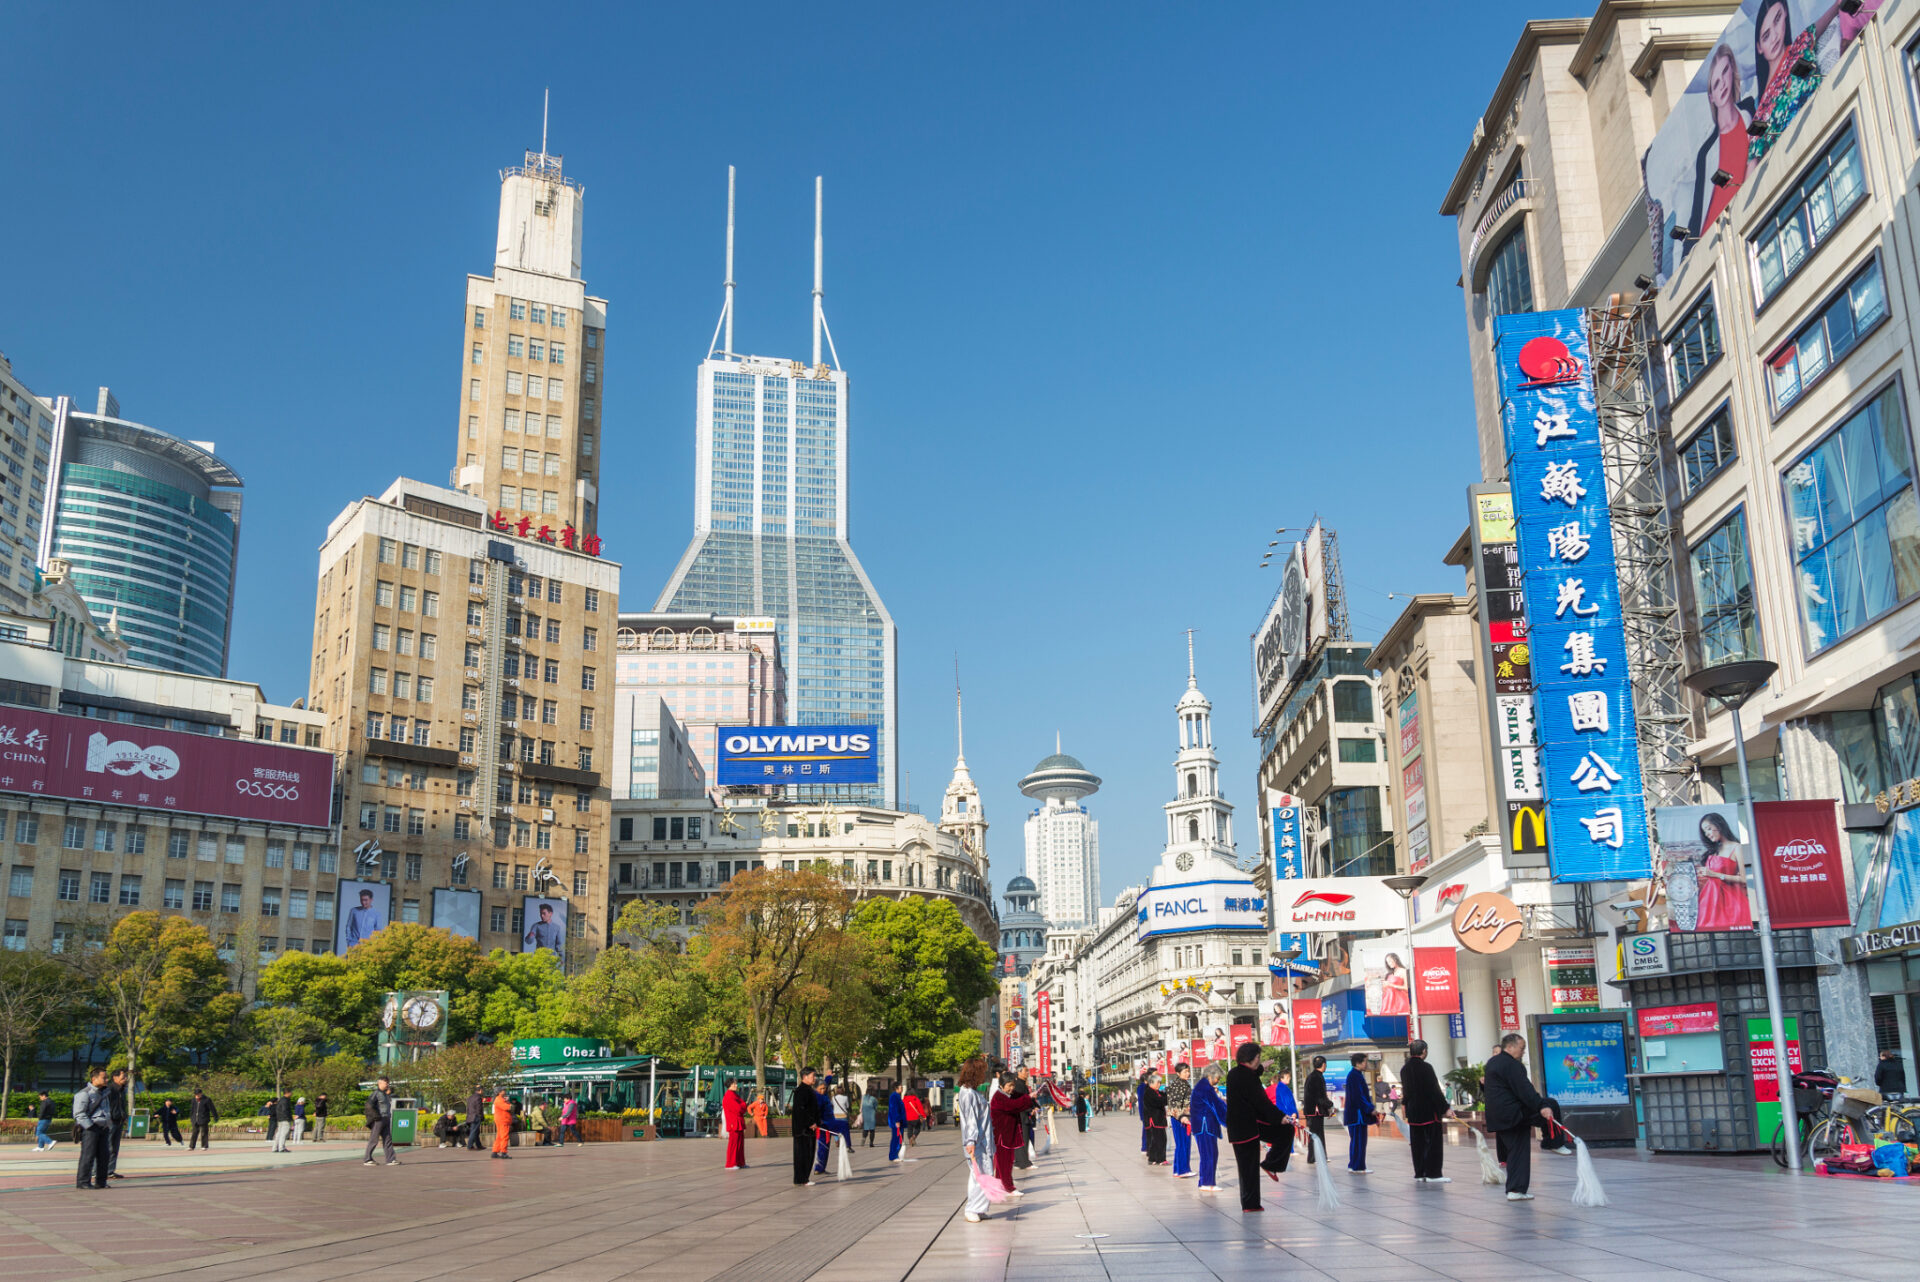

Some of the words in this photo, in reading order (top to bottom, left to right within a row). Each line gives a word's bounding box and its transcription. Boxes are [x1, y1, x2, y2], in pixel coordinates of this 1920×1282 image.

[1483, 547, 1504, 555] 5-6F
[1534, 410, 1623, 848] 江蘇陽光集團公司
[1494, 645, 1506, 653] 4F
[1506, 707, 1521, 744] SILK
[725, 734, 870, 753] OLYMPUS
[3, 752, 46, 764] CHINA
[116, 752, 168, 764] 1912-2012
[253, 767, 299, 783] 客服热线
[763, 764, 831, 775] 奥林巴斯
[1511, 749, 1526, 790] KING
[236, 779, 299, 800] 95566
[1774, 844, 1827, 857] ENICAR
[1155, 898, 1208, 917] FANCL
[1292, 910, 1355, 922] LI-NING
[1459, 903, 1523, 944] Lily
[1634, 956, 1659, 965] CMBC
[563, 1046, 596, 1058] Chez
[1750, 1047, 1799, 1057] CURRCY
[1751, 1057, 1800, 1066] EXCHGE
